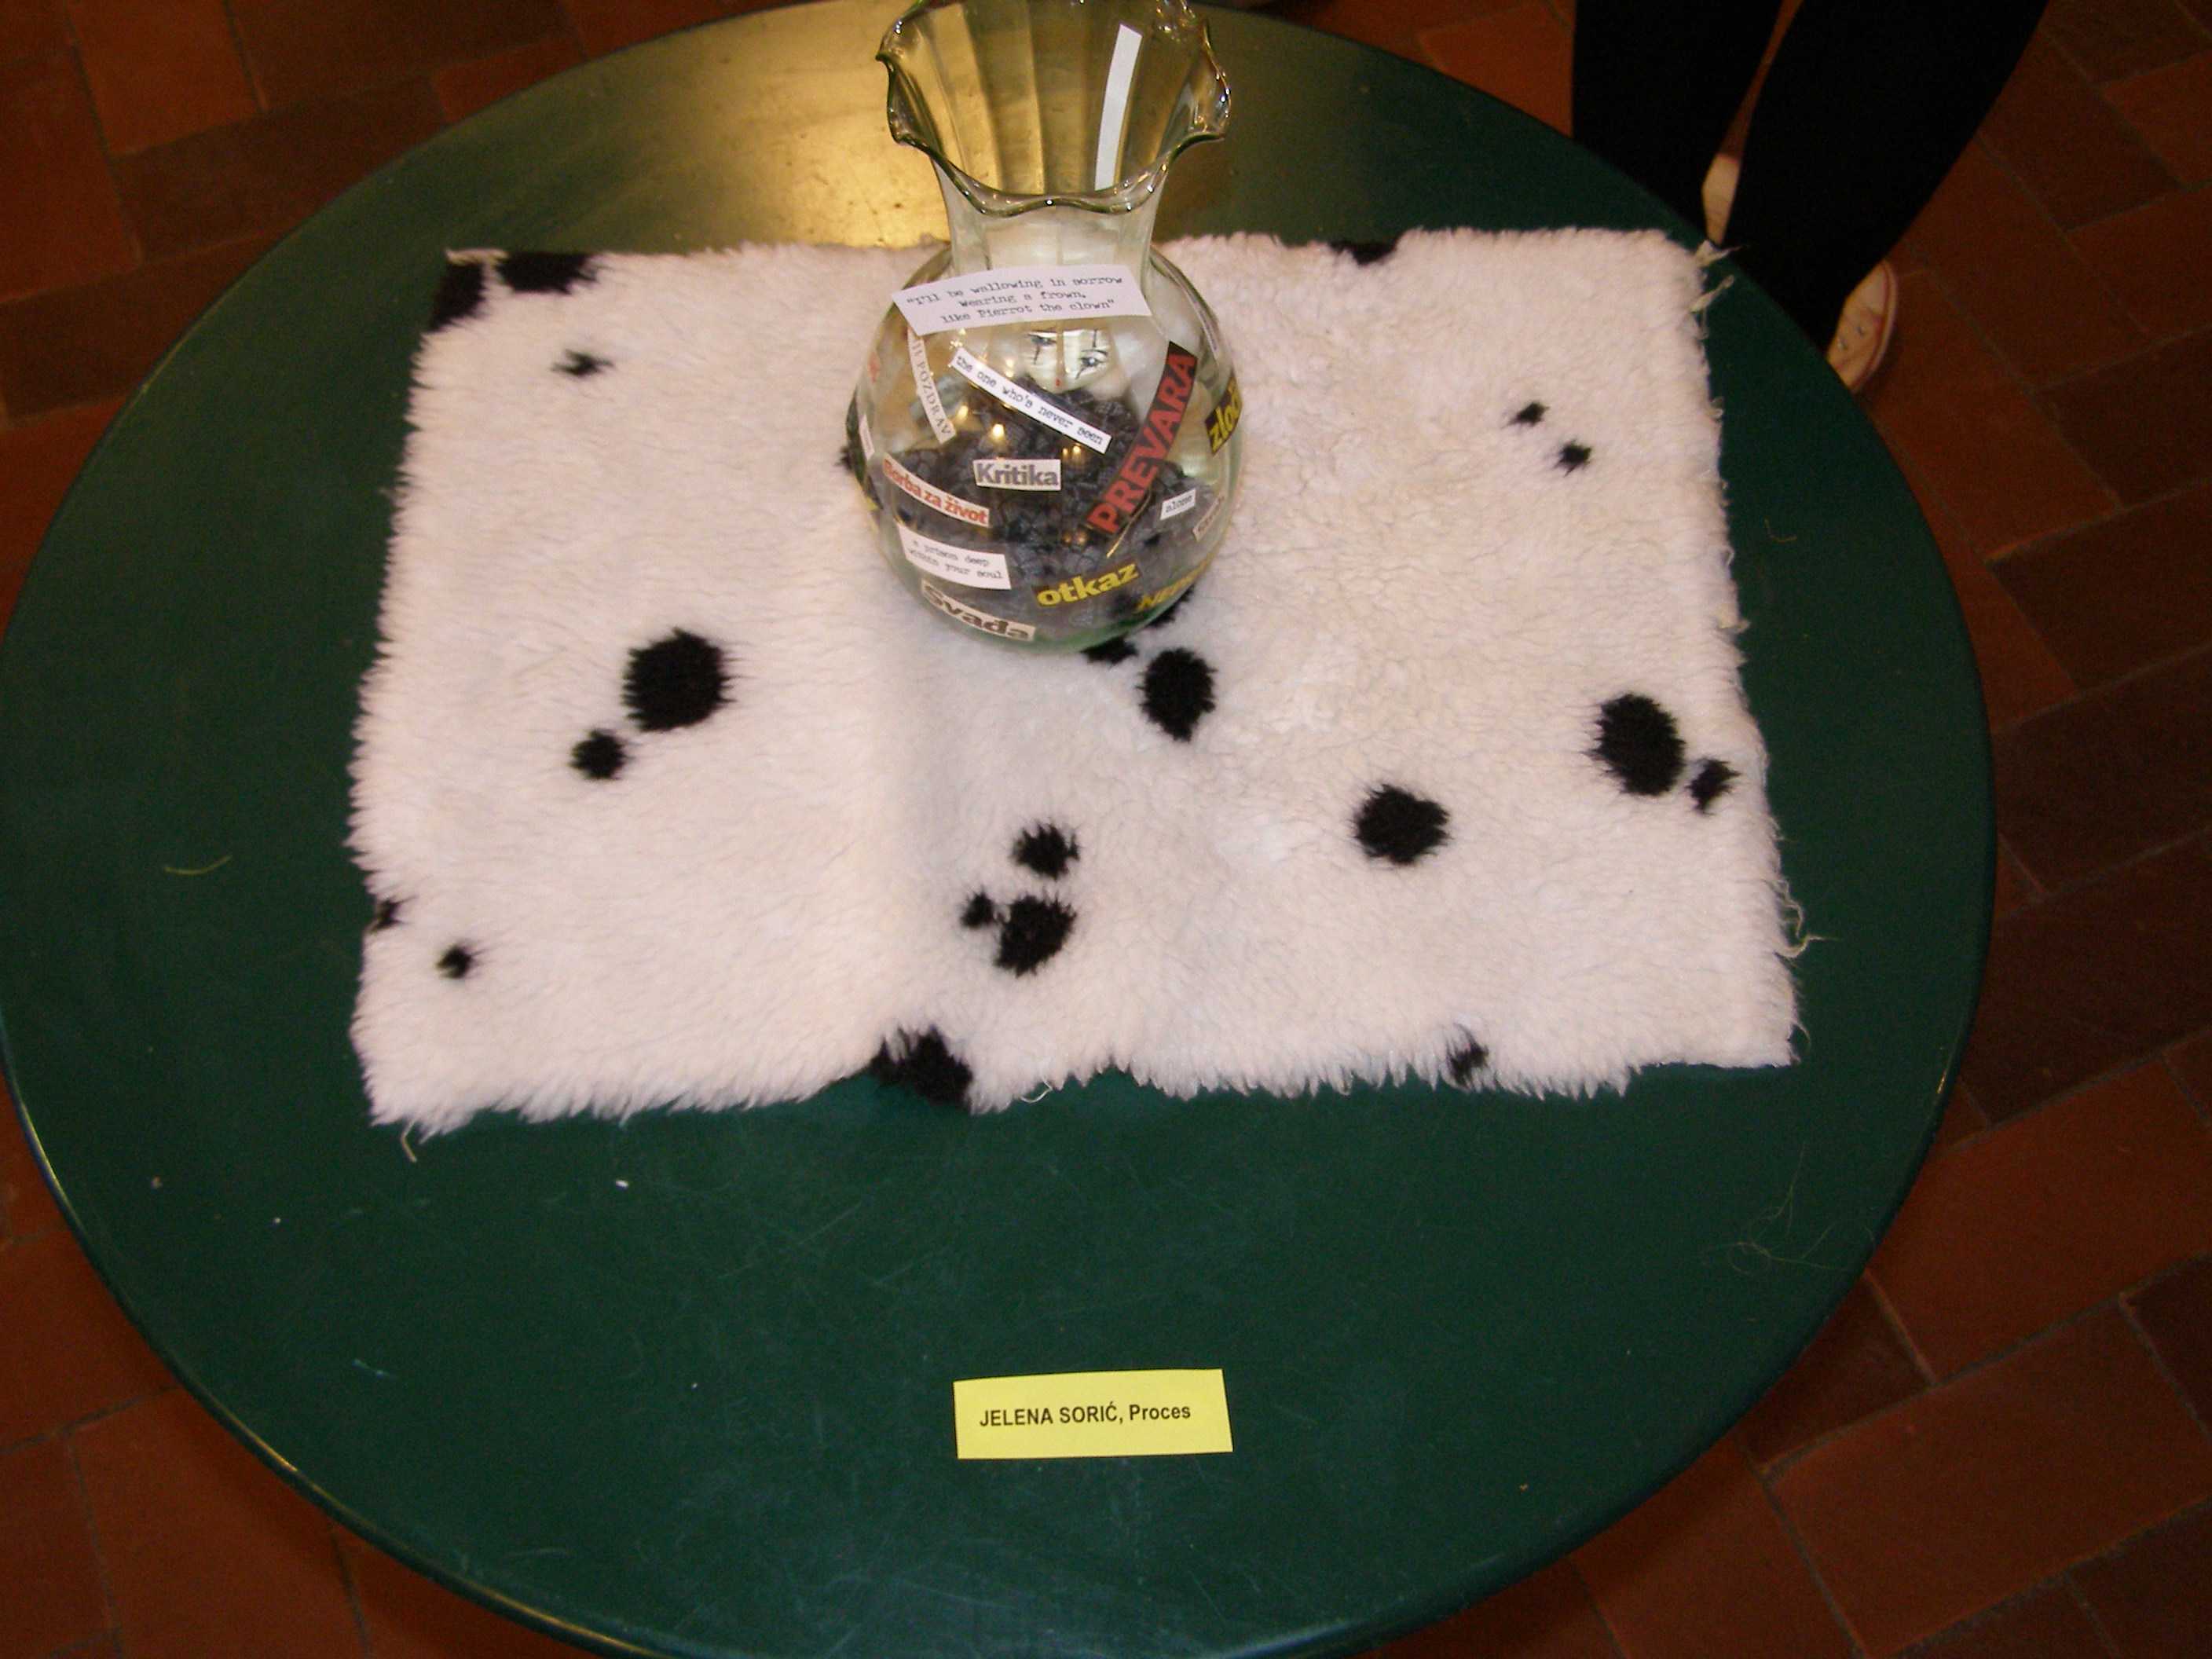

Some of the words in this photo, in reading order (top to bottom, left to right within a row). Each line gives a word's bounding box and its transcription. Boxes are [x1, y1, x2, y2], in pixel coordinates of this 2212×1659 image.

[949, 288, 965, 298] be
[971, 278, 1042, 294] wallowing
[1050, 277, 1066, 287] in
[1073, 276, 1123, 286] sorrow
[941, 312, 972, 324] like
[980, 303, 1033, 318] Pierrot
[1039, 302, 1063, 313] the
[956, 354, 974, 373] the
[976, 372, 998, 388] one
[1002, 385, 1033, 409] who's
[1038, 405, 1075, 429] never
[1075, 427, 1104, 445] seen
[1086, 353, 1196, 535] PREVARA
[976, 462, 1059, 486] Kritika
[924, 491, 942, 508] za
[945, 492, 987, 525] život
[1036, 562, 1139, 606] otkaz
[980, 1407, 1053, 1426] JELENA
[1060, 1401, 1124, 1425] SORIĆ,
[1130, 1404, 1191, 1421] Proces
